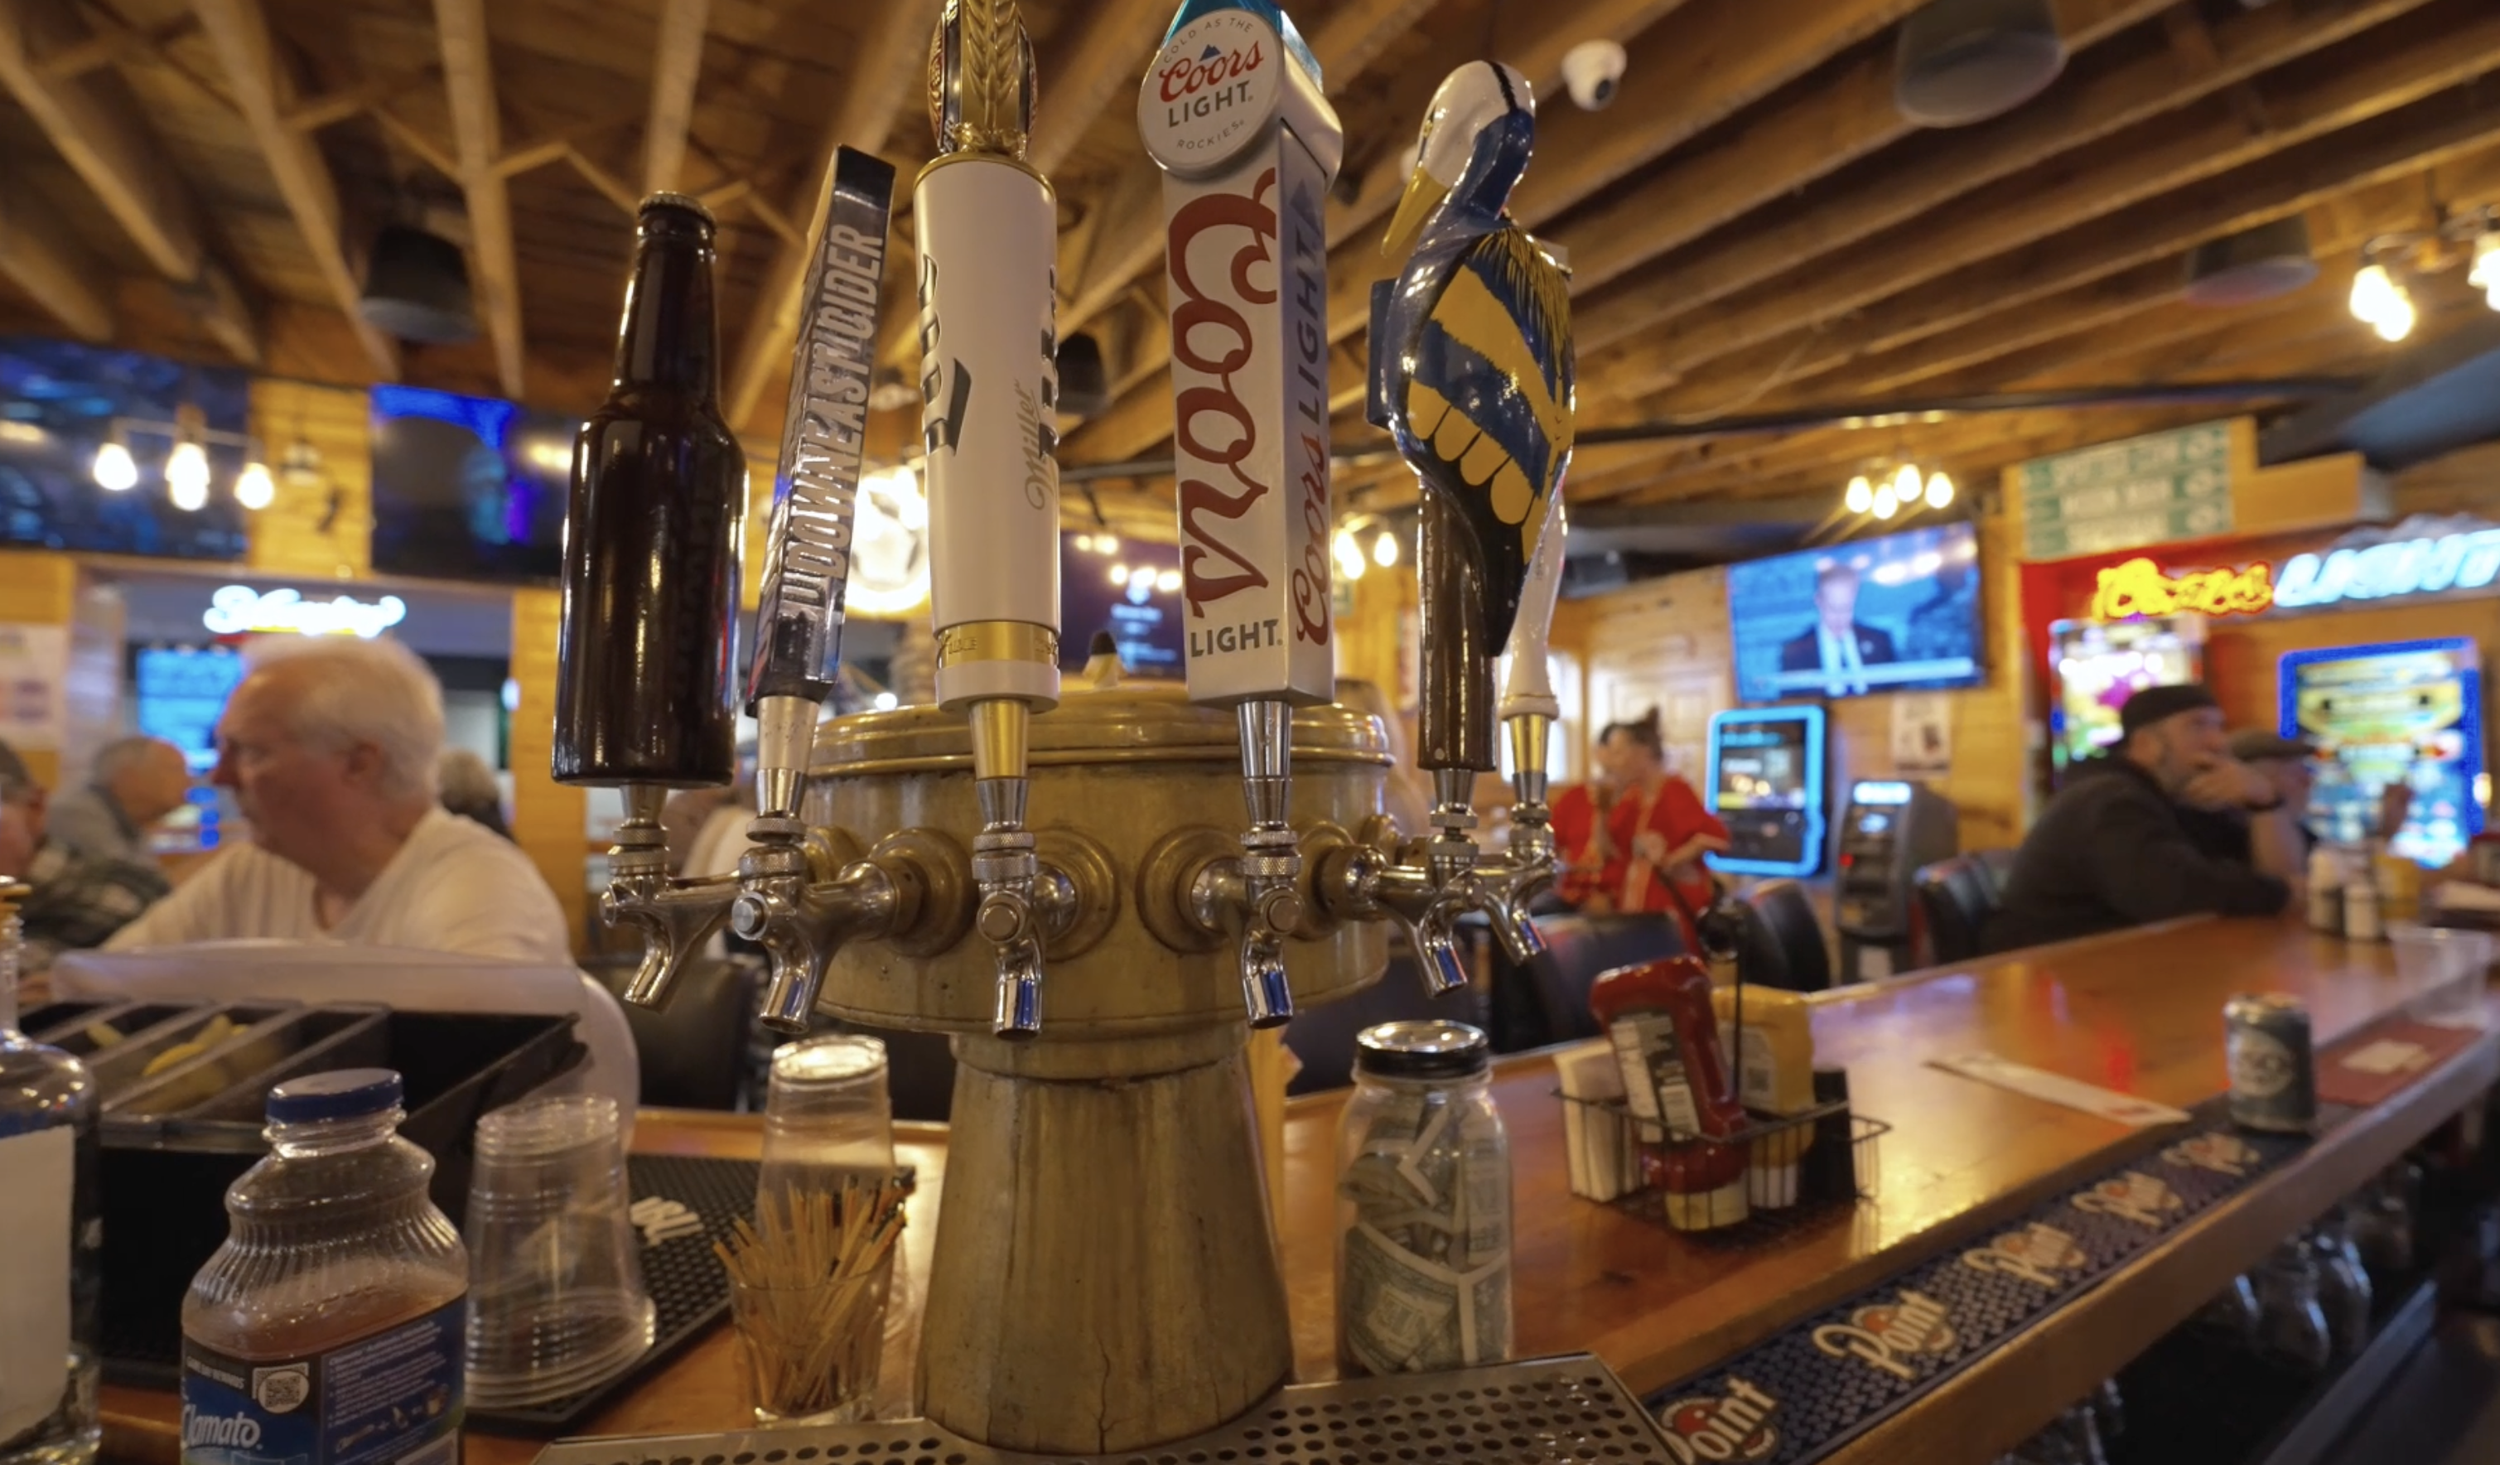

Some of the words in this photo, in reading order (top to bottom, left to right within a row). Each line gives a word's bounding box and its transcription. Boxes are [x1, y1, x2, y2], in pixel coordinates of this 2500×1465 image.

[1158, 40, 1264, 104] Coors
[1163, 29, 1197, 65] COLD
[1204, 18, 1223, 31] AS
[1229, 17, 1255, 34] THE
[1168, 80, 1251, 129] LIGHT
[817, 222, 884, 340] CIDER
[1294, 226, 1322, 425] LIGHT
[1012, 377, 1056, 511] Miller
[1168, 166, 1278, 619] Coors
[1291, 431, 1330, 648] Coors
[1189, 617, 1280, 658] LIGHT
[1812, 1287, 1948, 1380] Point
